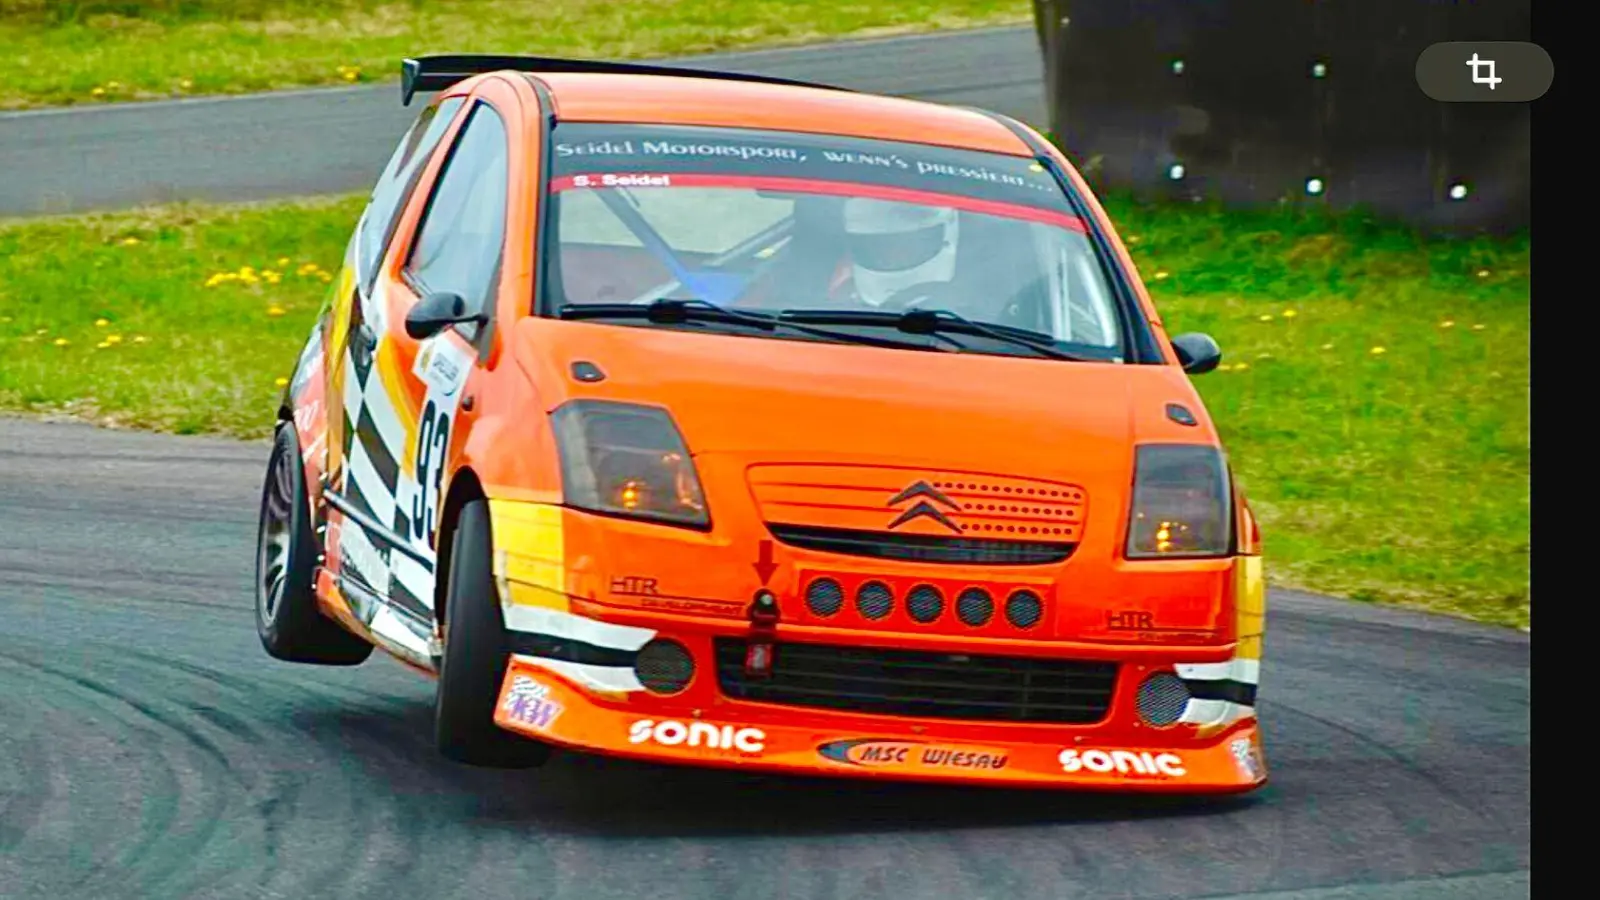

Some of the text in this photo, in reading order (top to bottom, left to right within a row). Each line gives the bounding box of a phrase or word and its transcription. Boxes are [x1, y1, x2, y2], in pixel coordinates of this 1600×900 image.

[601, 174, 671, 187] Seidel
[412, 400, 450, 551] 93
[860, 746, 1009, 769] MSC WIESAU
